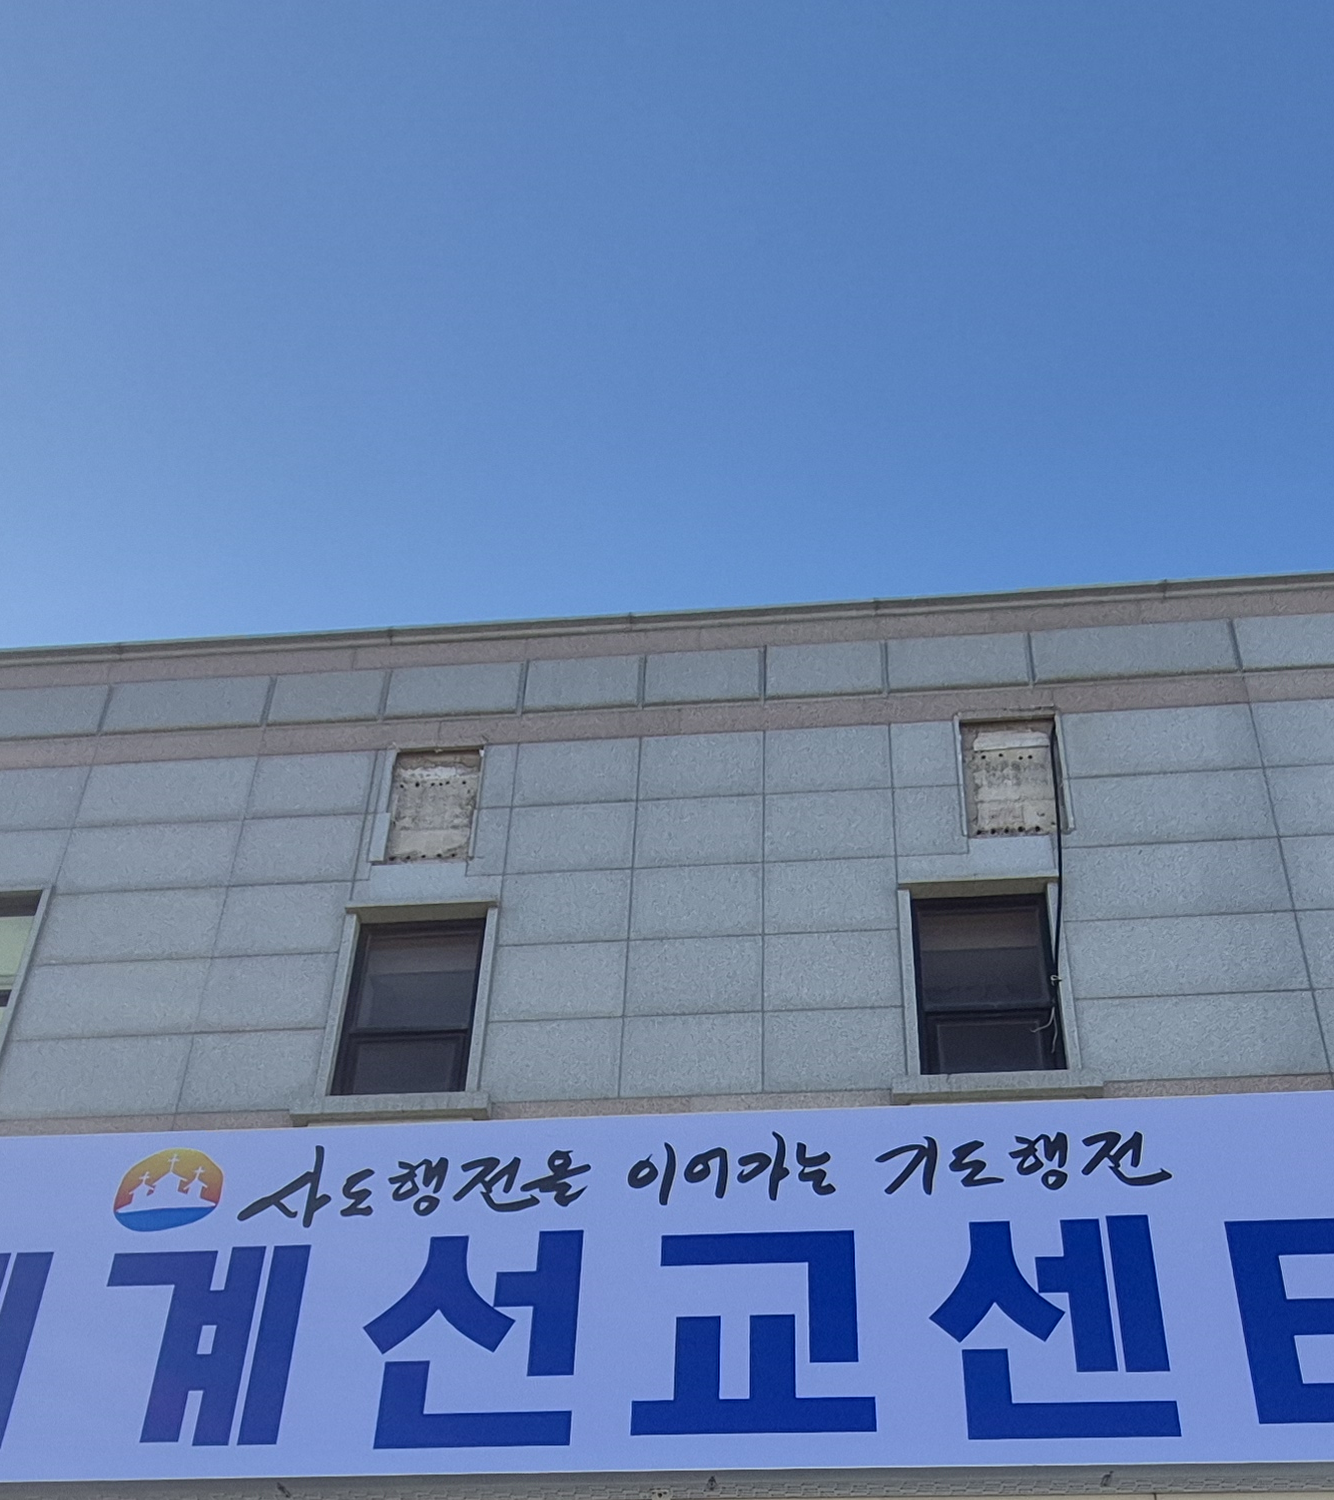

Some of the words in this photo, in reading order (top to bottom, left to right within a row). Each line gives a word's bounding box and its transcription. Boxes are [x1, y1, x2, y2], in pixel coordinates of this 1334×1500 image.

[237, 1145, 592, 1228] 사도행전을
[627, 1131, 839, 1206] 이어가는
[875, 1130, 1174, 1197] 기도행전
